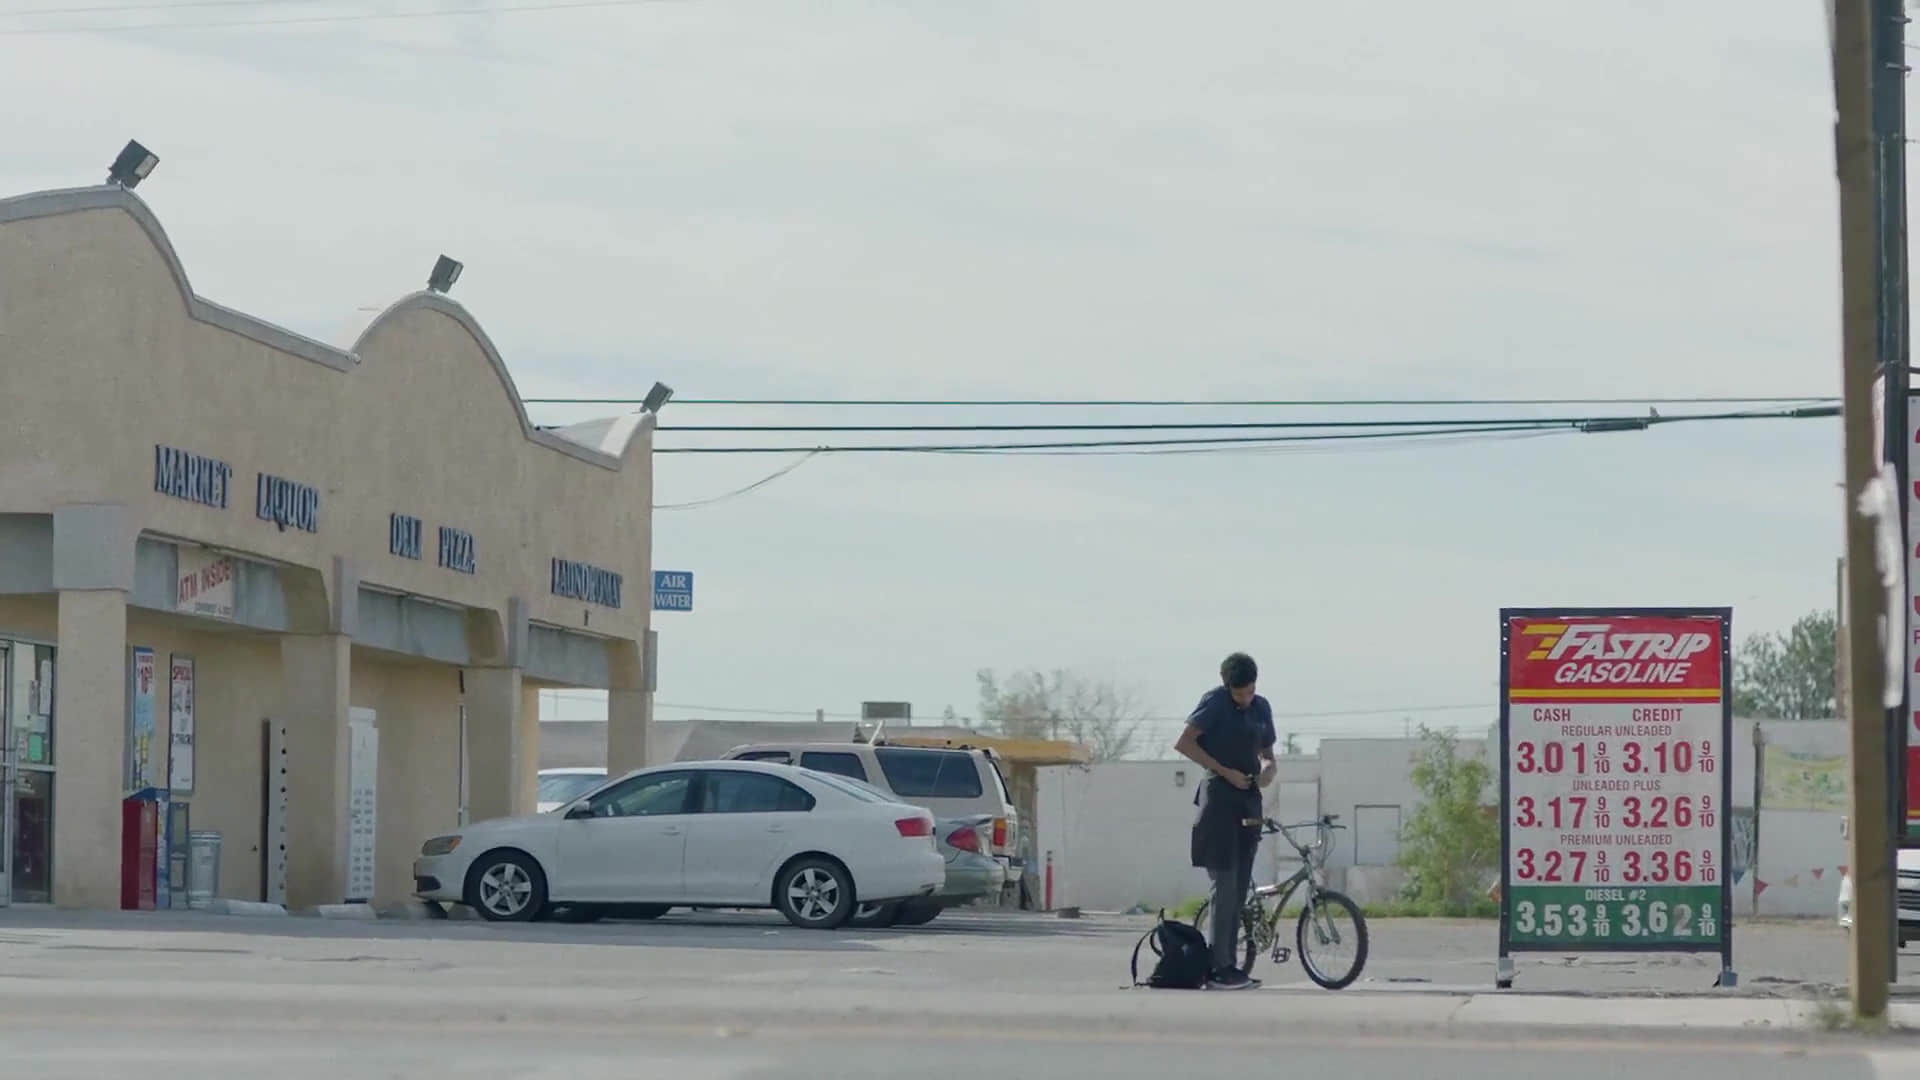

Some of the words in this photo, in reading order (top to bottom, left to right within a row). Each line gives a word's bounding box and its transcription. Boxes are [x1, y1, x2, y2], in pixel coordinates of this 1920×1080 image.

[154, 444, 232, 509] MARKET
[256, 472, 320, 533] LIQUOR
[390, 513, 422, 560] DELI
[439, 526, 476, 575] PIZZA
[179, 573, 198, 604] ATM
[551, 557, 622, 608] LAUNDROMAT
[661, 575, 687, 588] AIR
[655, 594, 691, 608] WATER
[1547, 624, 1711, 659] FASTRIP
[1555, 662, 1691, 683] GASOLINE
[1534, 709, 1570, 721] CASH
[1633, 709, 1682, 721] CREDIT
[1562, 725, 1612, 736] REGULAR
[1615, 725, 1672, 736] UNLEADED
[1517, 742, 1584, 774] 3.01
[1623, 742, 1691, 773] 3.10
[1573, 780, 1629, 791] UNLEADED
[1633, 780, 1661, 791] PLUS
[1517, 797, 1587, 828] 3.17
[1623, 797, 1692, 828] 3.26
[1561, 834, 1612, 845] PREMIUM
[1616, 834, 1672, 845] UNLEADED
[1518, 848, 1586, 882] 3.27
[1623, 851, 1691, 882] 3.36
[1585, 889, 1624, 901] DIESEL
[1629, 889, 1646, 900] #2
[1517, 901, 1587, 936] 3.53
[1622, 901, 1692, 936] 3.62
